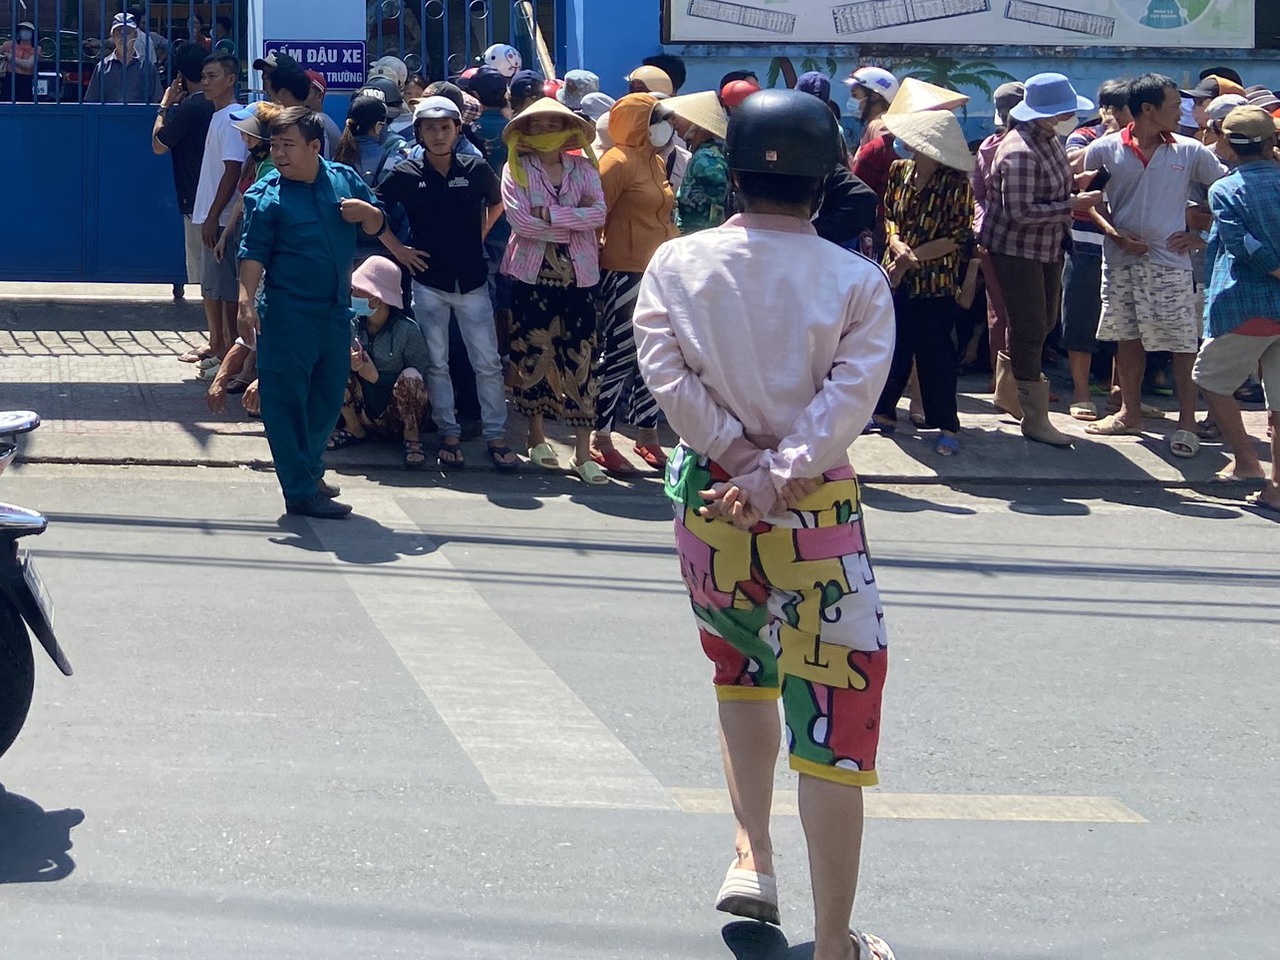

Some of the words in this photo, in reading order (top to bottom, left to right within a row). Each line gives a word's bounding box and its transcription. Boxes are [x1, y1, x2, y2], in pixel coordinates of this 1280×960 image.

[307, 46, 337, 66] ĐẬU
[342, 49, 361, 63] XE
[326, 69, 362, 83] TRƯỜNG
